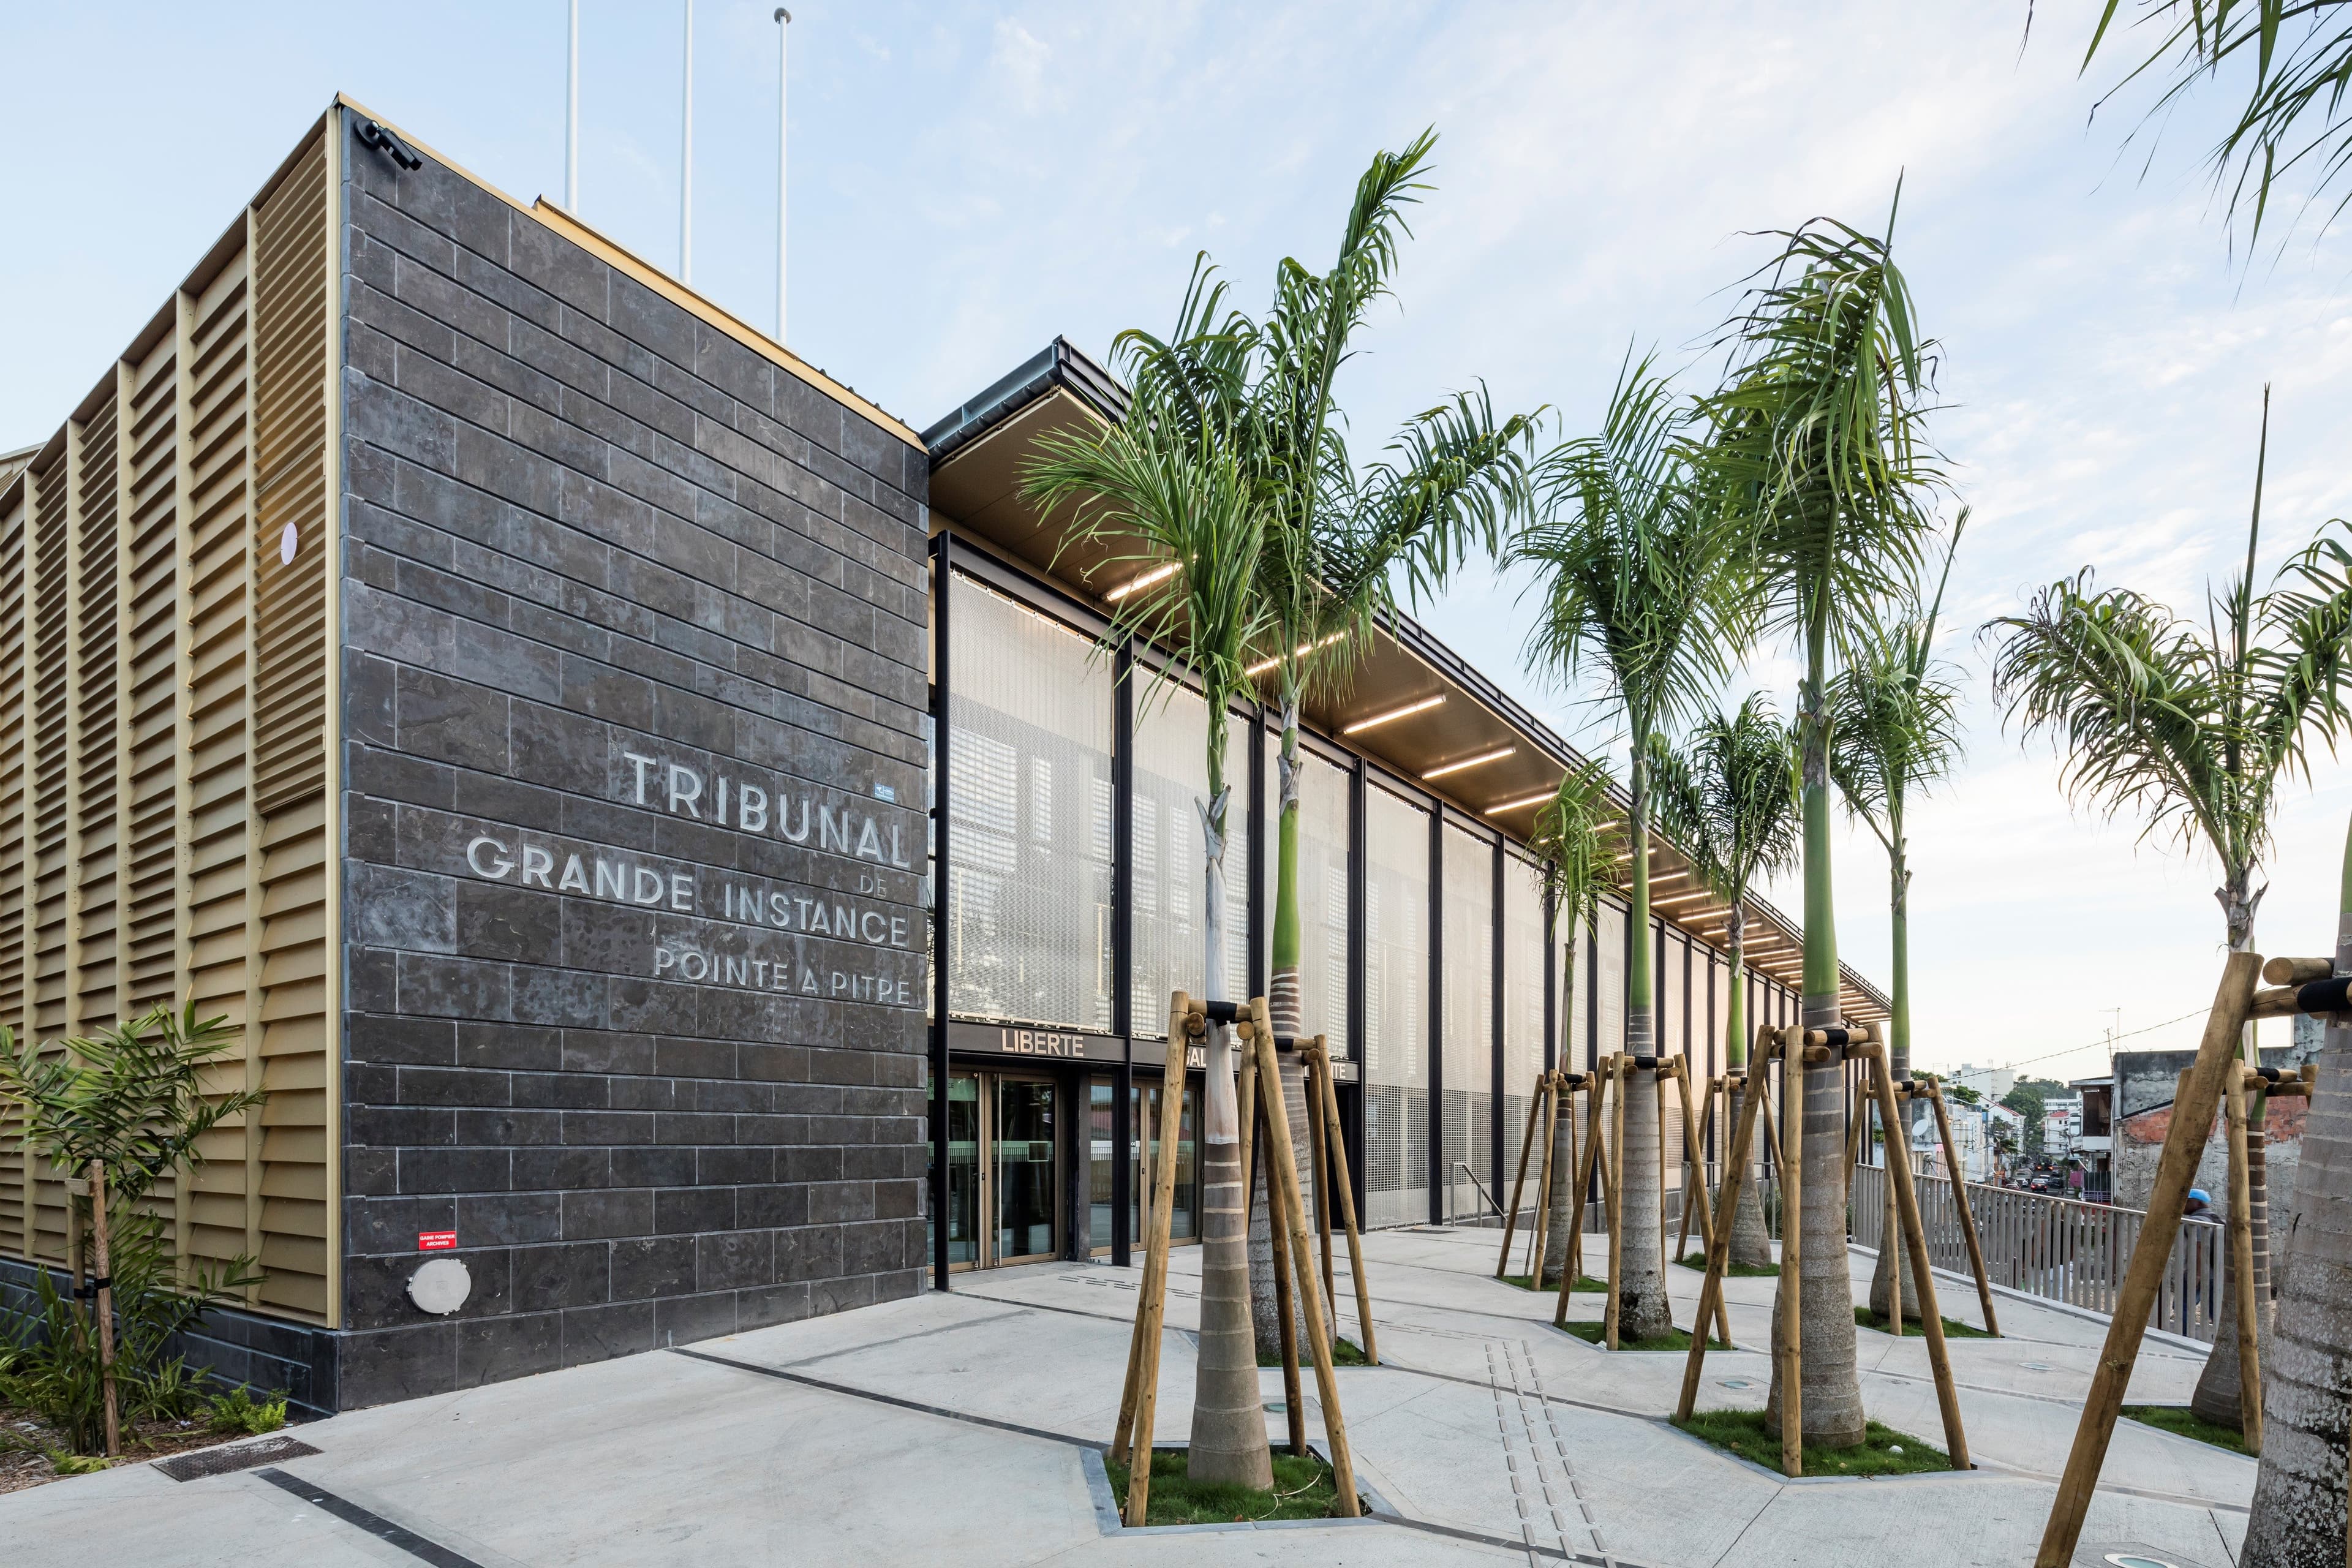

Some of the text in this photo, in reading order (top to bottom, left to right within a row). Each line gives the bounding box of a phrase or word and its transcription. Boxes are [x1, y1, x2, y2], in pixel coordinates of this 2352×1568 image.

[624, 751, 911, 869] TRIBUNAL
[466, 836, 908, 947] GRANDE INSTANCE
[860, 874, 886, 897] DE
[655, 948, 910, 1006] POINTE A PITRE
[1001, 1029, 1084, 1057] LIBERTE
